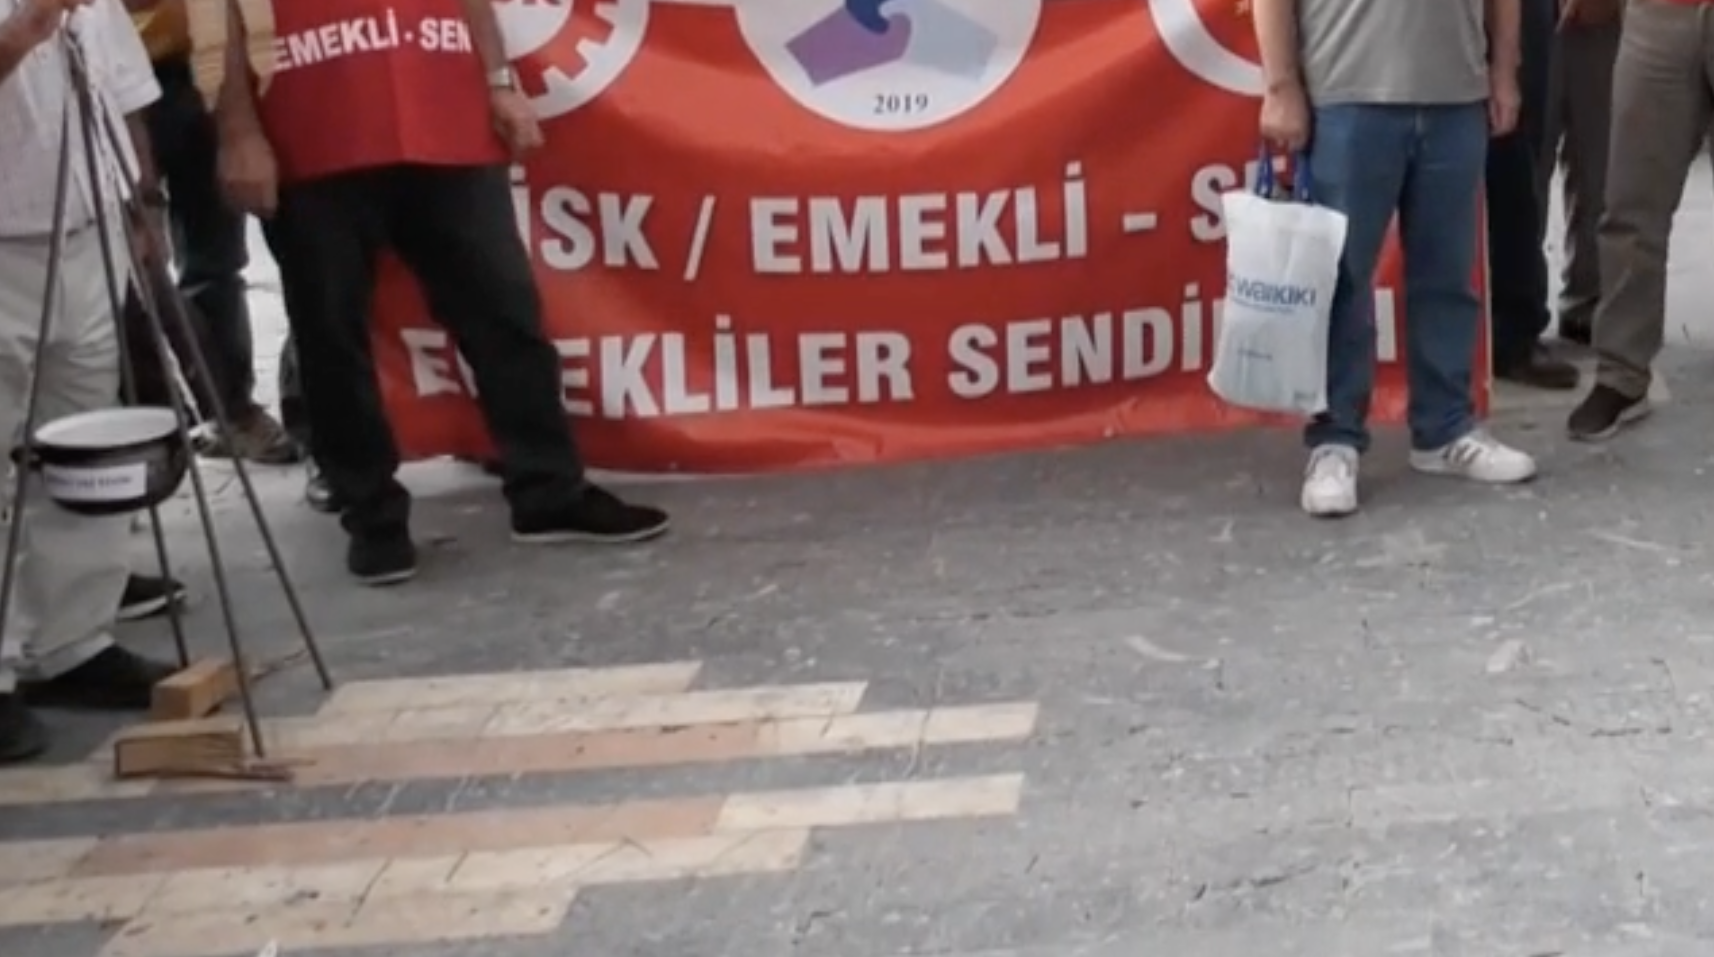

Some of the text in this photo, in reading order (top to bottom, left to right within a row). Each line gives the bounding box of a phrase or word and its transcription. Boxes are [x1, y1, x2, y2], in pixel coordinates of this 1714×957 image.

[272, 7, 399, 72] EMEKLİ
[419, 17, 472, 53] SEN
[874, 94, 929, 114] 2019
[509, 165, 659, 271] İSK
[684, 195, 715, 282] /
[751, 161, 1088, 274] EMEKLİ
[400, 314, 913, 419] EEKLİLER
